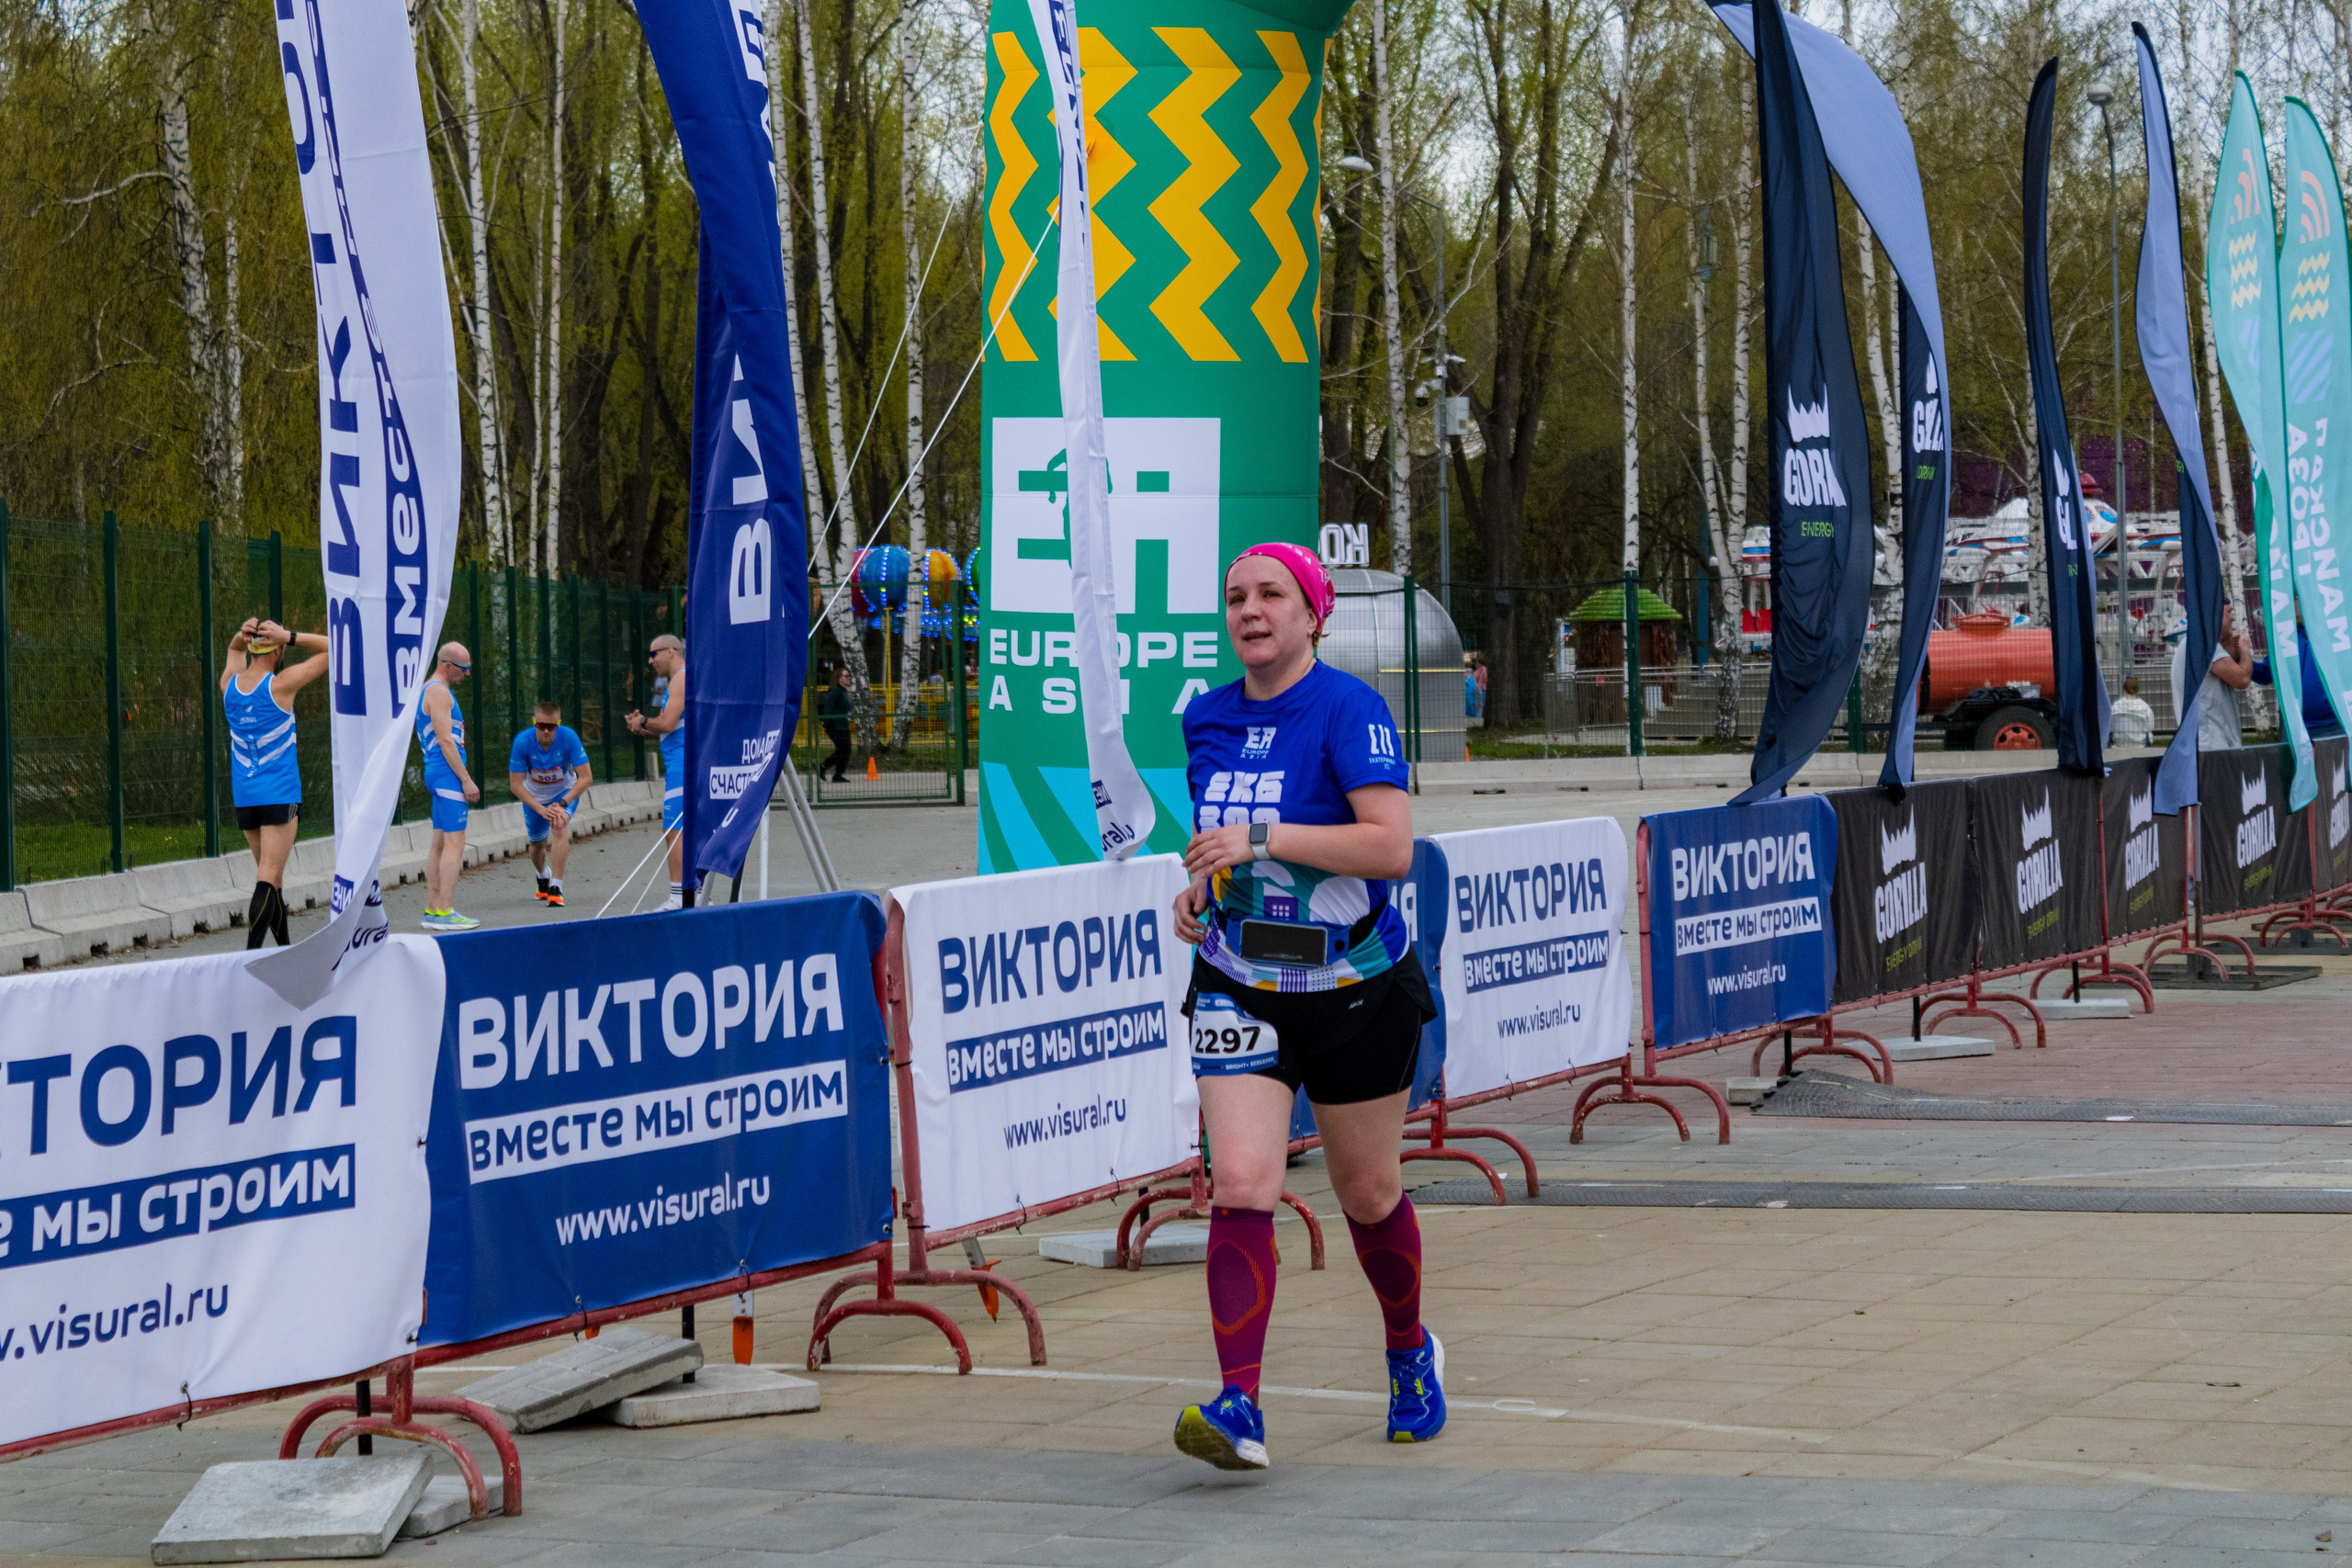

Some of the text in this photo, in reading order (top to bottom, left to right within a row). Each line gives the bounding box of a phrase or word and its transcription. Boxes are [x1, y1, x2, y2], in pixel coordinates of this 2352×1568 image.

[276, 0, 367, 716] ВИКТО
[1671, 831, 1815, 901] ВИКТОРИЯ
[2125, 823, 2159, 891] GORILLA
[2237, 806, 2277, 869] GORILLA
[1455, 858, 1607, 933] ВИКТОРИЯ
[1874, 862, 1928, 944] GORILLA
[2017, 839, 2064, 914] GORILLA
[938, 909, 1162, 1014] ВИКТОРИЯ
[1465, 936, 1608, 987] вместе мы строим
[1677, 903, 1818, 949] вместе мы строим
[1708, 960, 1786, 995] www.visural.ru
[459, 953, 844, 1089] ВИКТОРИЯ
[947, 1009, 1165, 1085] вместе мы строим
[1194, 1026, 1261, 1055] 2297
[1498, 999, 1581, 1039] www.visural.ru
[0, 1015, 357, 1156] ТОРИЯ
[469, 1070, 843, 1172] вместе мы строим
[1003, 1093, 1126, 1150] www.visural.ru
[32, 1193, 121, 1252] мы
[139, 1154, 350, 1235] строим
[556, 1172, 770, 1246] www.visural.ru
